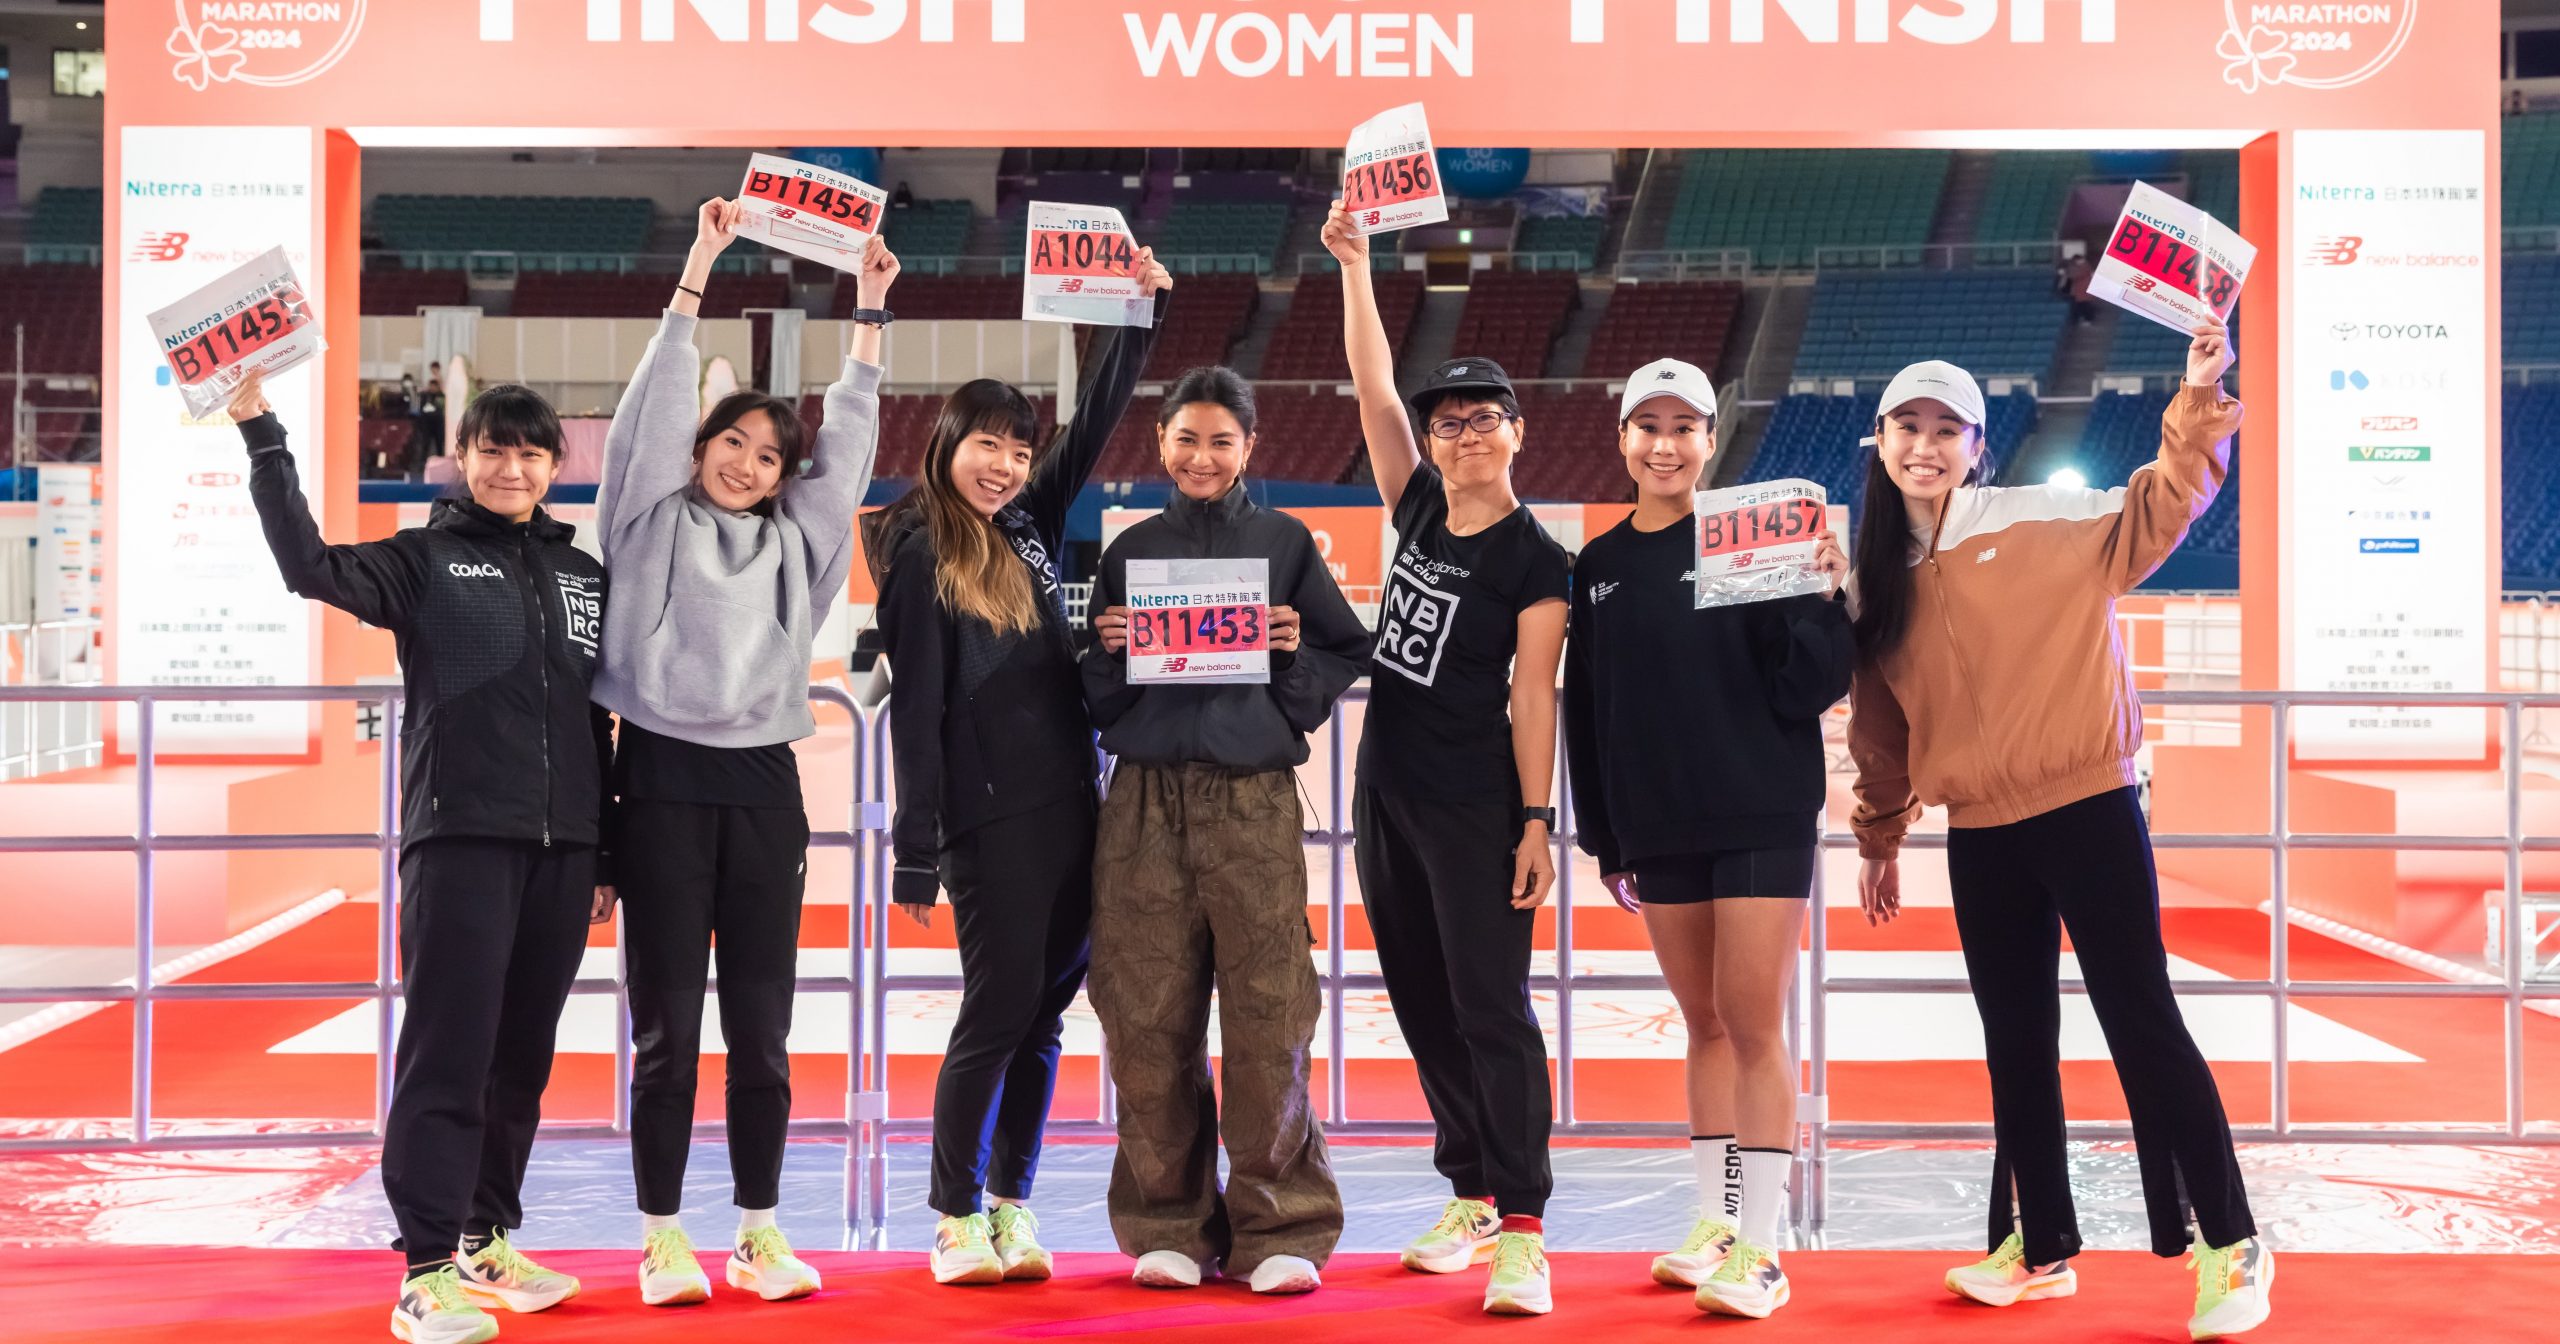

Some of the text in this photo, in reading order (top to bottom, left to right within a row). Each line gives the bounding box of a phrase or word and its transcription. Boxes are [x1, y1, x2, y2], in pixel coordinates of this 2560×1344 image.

[202, 3, 340, 21] MARATHON
[2251, 5, 2390, 23] MARATHON
[240, 29, 301, 48] 2024
[1123, 12, 1473, 77] WOMEN
[2290, 32, 2352, 50] 2024
[816, 153, 842, 166] GO
[1449, 159, 1512, 172] WOMEN
[1345, 155, 1431, 203] B11456
[127, 181, 202, 197] Niterra
[2299, 185, 2374, 200] Niterra
[750, 171, 871, 226] B11454
[1396, 211, 1423, 220] balance
[795, 218, 811, 227] new
[813, 221, 844, 239] balance
[193, 252, 225, 262] new
[2114, 220, 2233, 307] B11458
[2366, 255, 2400, 266] new
[2406, 253, 2479, 266] balance
[1100, 286, 1131, 295] balance
[2152, 292, 2169, 303] new
[2170, 298, 2200, 320] balance
[165, 312, 222, 349] Niterra
[2365, 324, 2448, 338] TOYOTA
[263, 344, 297, 365] balance
[1705, 501, 1821, 549] B11457
[1400, 552, 1439, 585] run club
[1426, 556, 1470, 578] balance
[1755, 557, 1770, 566] new
[1772, 553, 1805, 563] balance
[449, 563, 504, 578] COACH
[570, 573, 600, 583] balance
[569, 595, 600, 618] NB
[1131, 594, 1188, 607] Niterra
[1389, 584, 1439, 632] NB
[573, 614, 599, 638] RC
[1134, 606, 1260, 648] B11453
[1382, 619, 1428, 665] RC
[1188, 664, 1205, 672] new
[1207, 662, 1241, 672] balance
